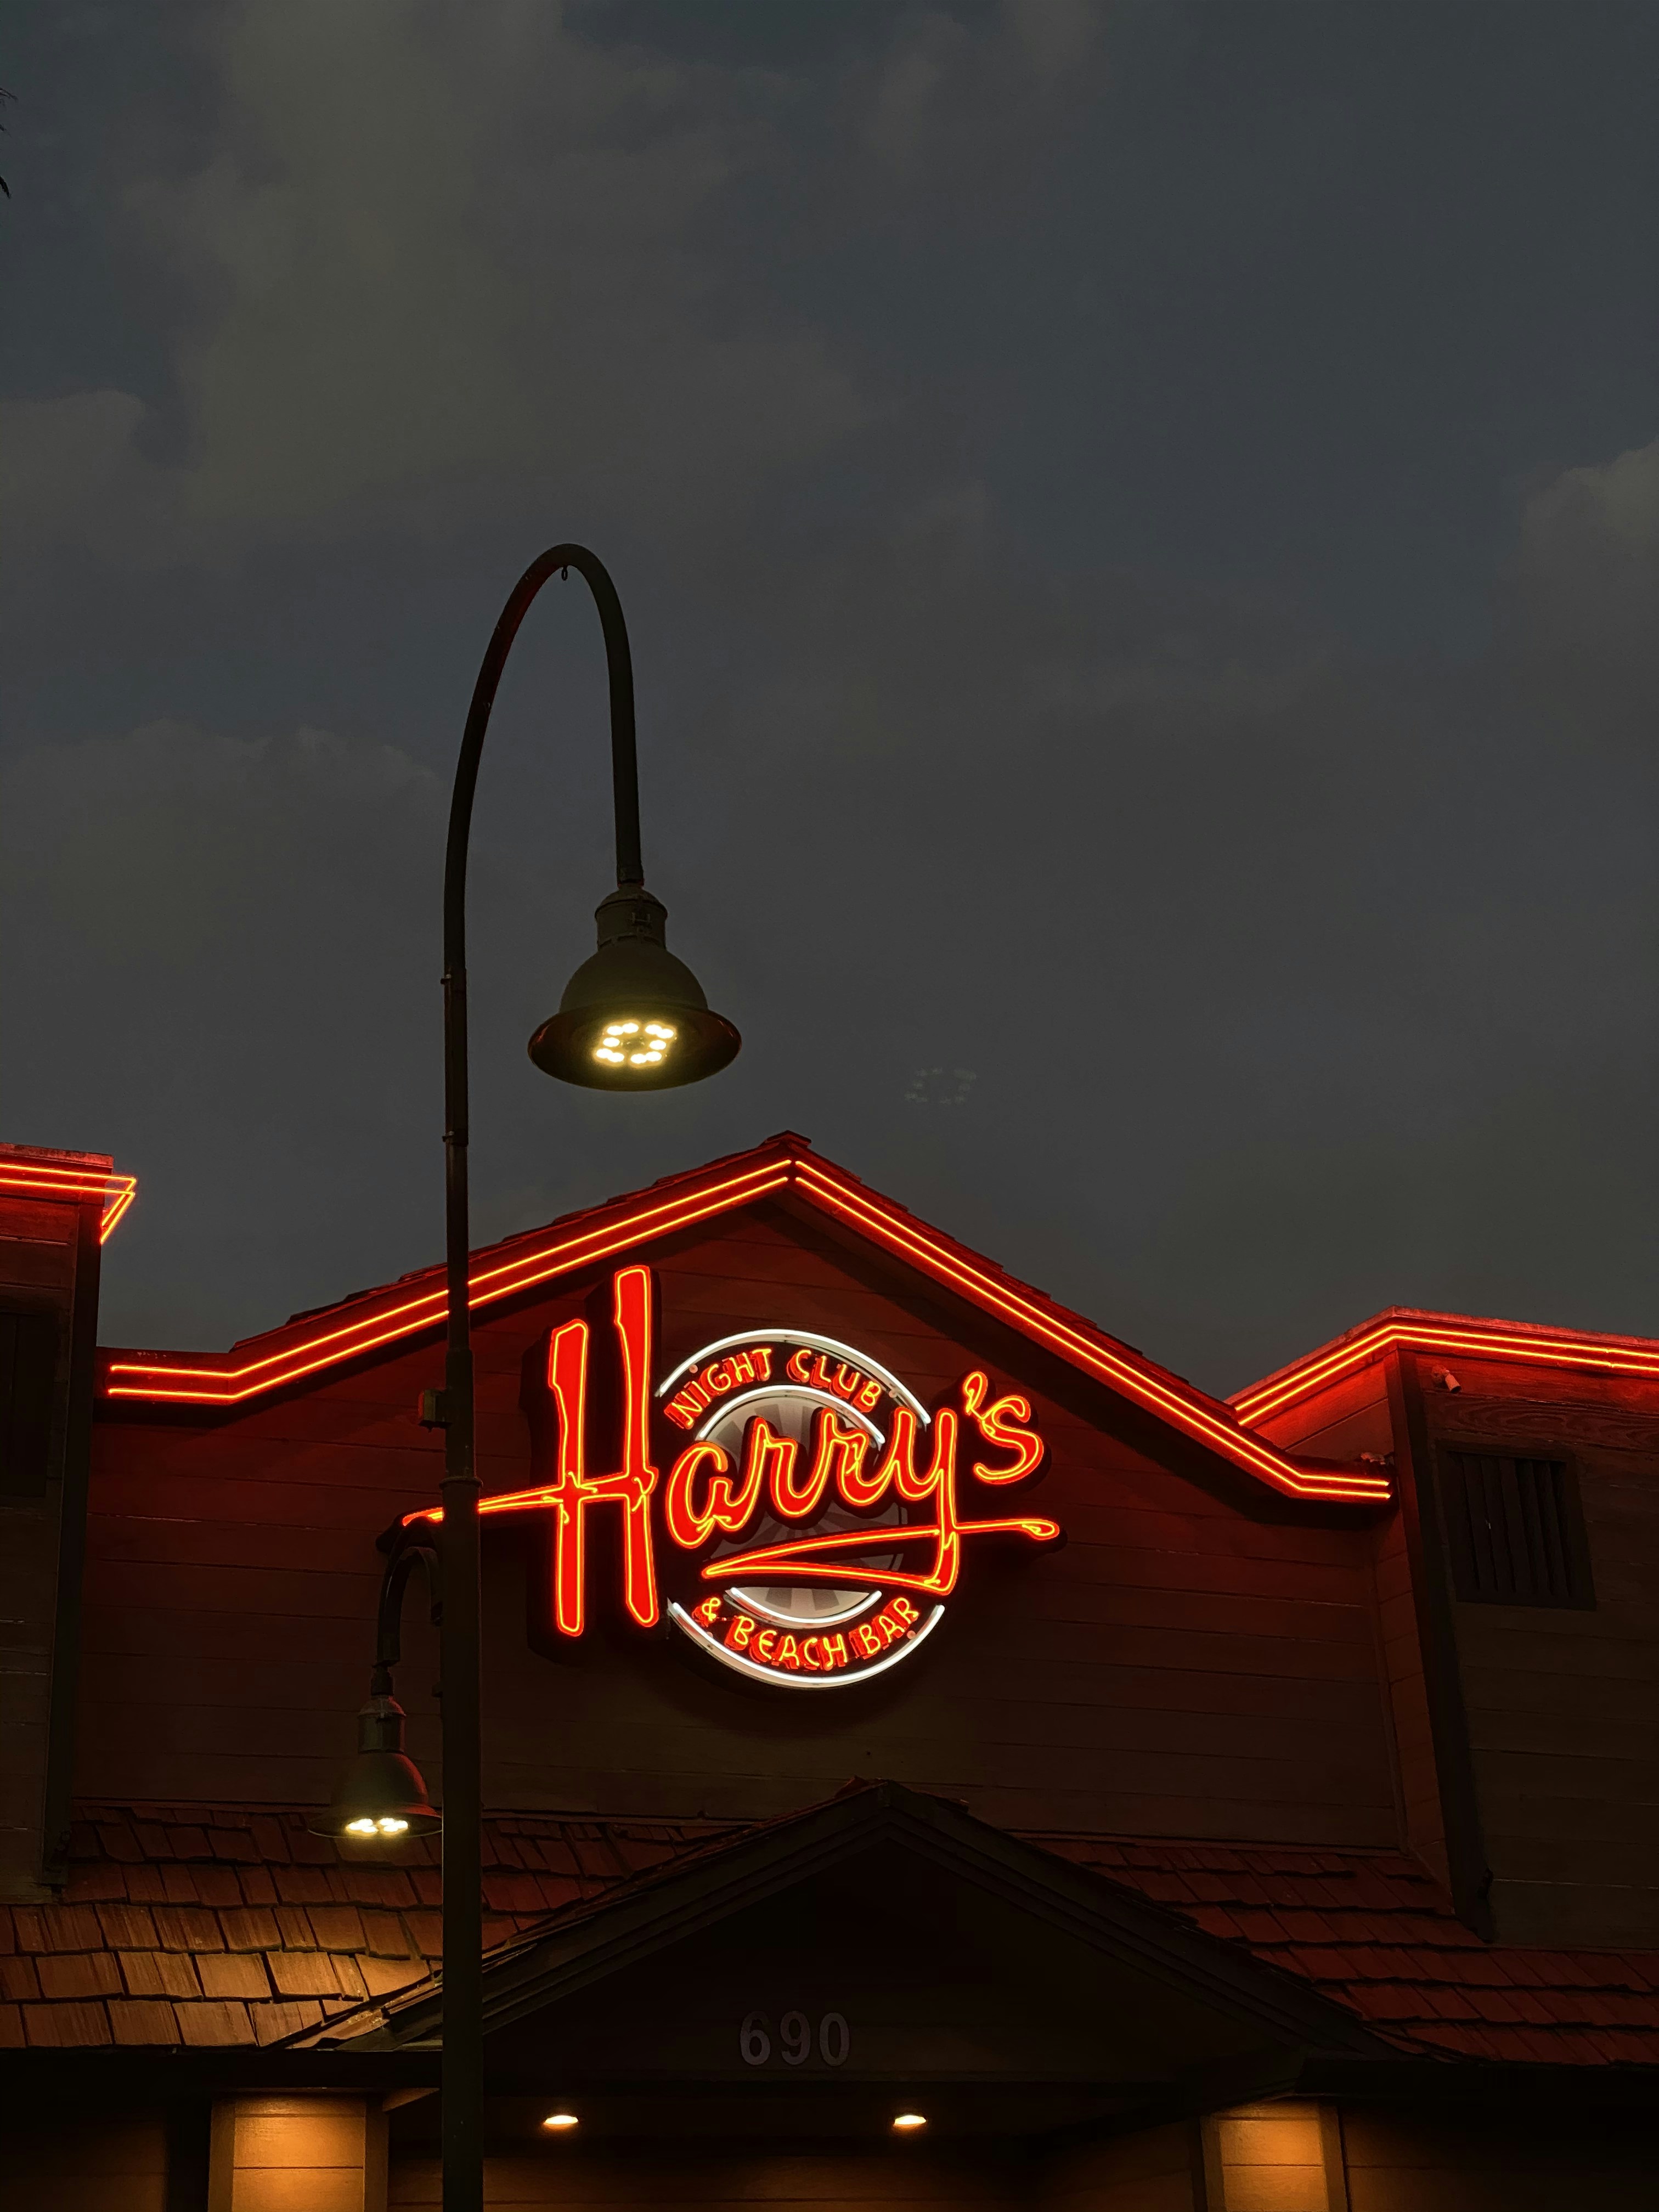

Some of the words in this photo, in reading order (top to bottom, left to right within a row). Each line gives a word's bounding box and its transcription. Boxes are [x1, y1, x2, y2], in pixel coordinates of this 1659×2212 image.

[664, 1347, 772, 1430] NIGHT
[786, 1348, 883, 1413] CLUB
[402, 1264, 1060, 1637] Harry's
[691, 1596, 722, 1628] &
[724, 1614, 848, 1671] BEACH
[849, 1596, 920, 1660] BAR
[740, 2010, 851, 2067] 690
